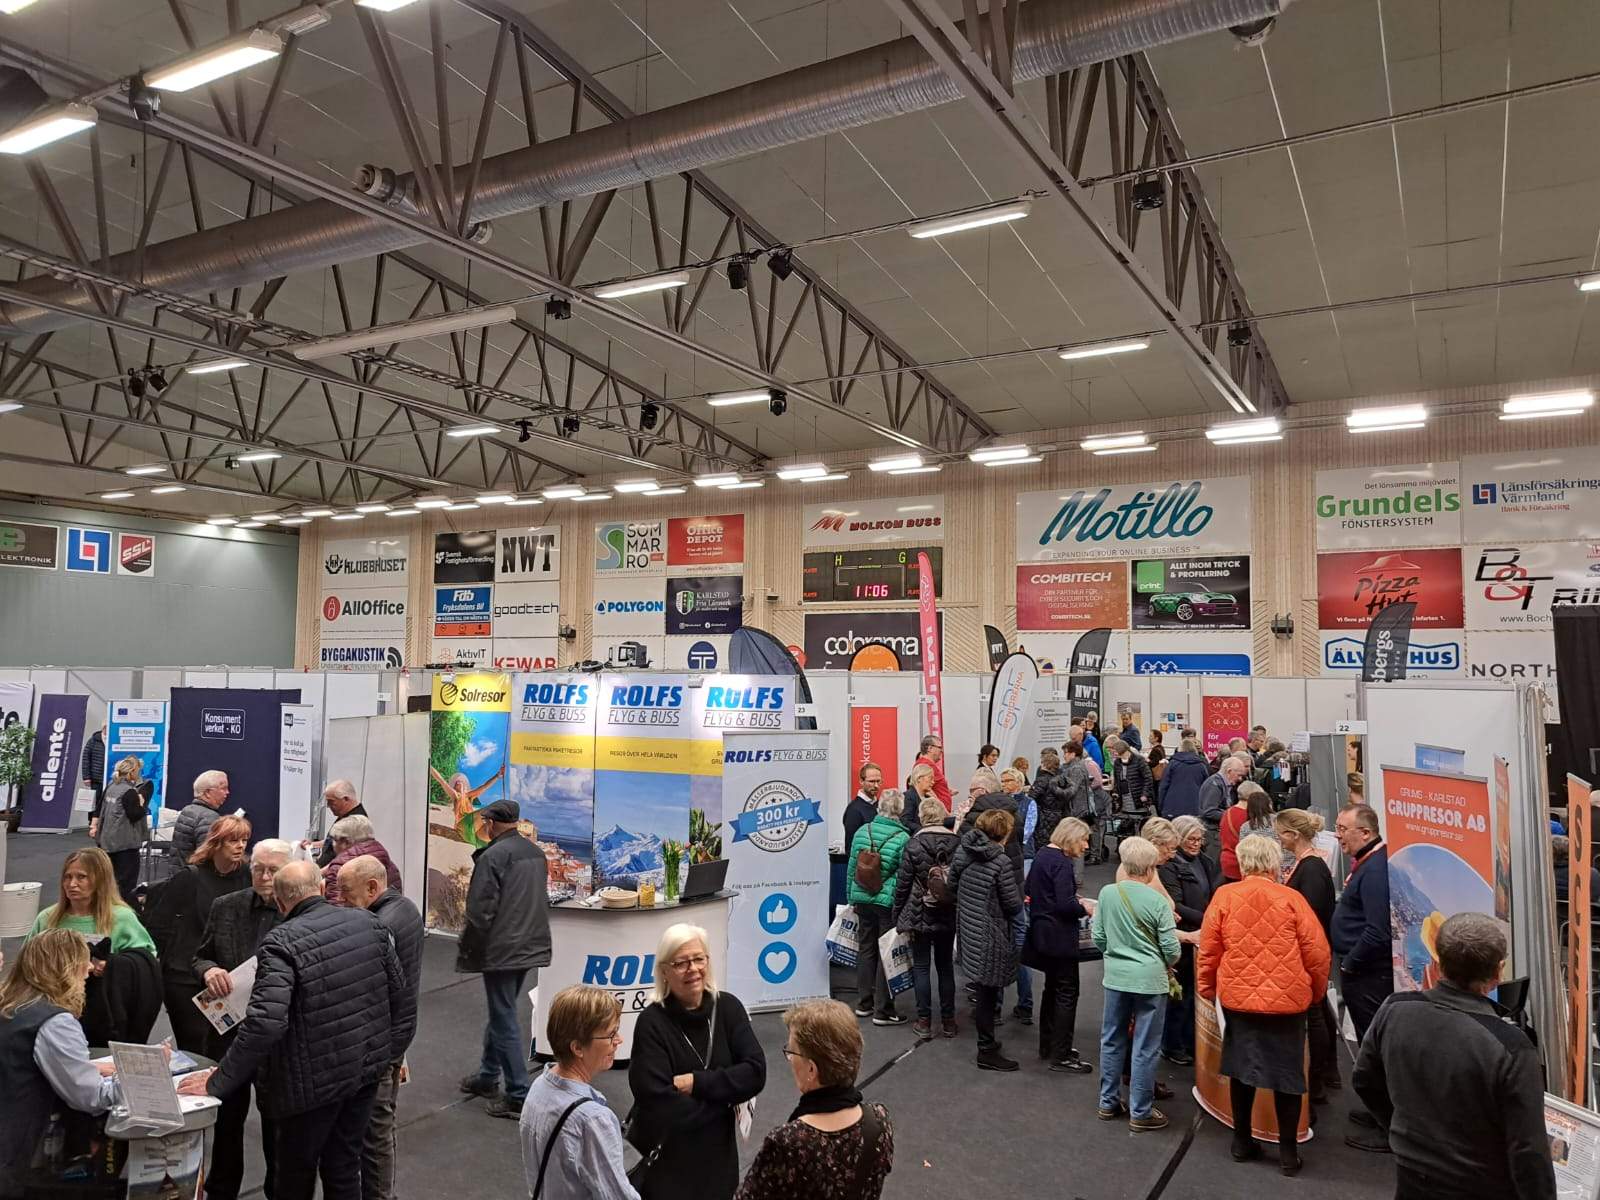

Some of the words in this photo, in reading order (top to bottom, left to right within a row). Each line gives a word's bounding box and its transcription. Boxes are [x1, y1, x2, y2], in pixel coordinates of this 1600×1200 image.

[1317, 489, 1460, 518] Grundels
[1502, 491, 1564, 503] Värmland
[1039, 481, 1213, 545] Motillo
[627, 522, 662, 537] SOM
[849, 520, 903, 531] MOLKOM
[906, 517, 942, 527] BUSS
[1342, 517, 1434, 528] FÖNSTERSYSTEM
[627, 538, 660, 553] MAR
[687, 535, 723, 544] DEPOT
[122, 540, 152, 562] SSL
[502, 534, 555, 573] NWT
[898, 552, 906, 563] G
[1052, 550, 1094, 558] EXPANDING
[1097, 549, 1117, 557] YOUR
[1119, 548, 1148, 556] ONLINE
[344, 558, 407, 574] KLUBBHUSET
[627, 554, 649, 568] RO
[834, 555, 842, 566] H
[1030, 572, 1112, 584] COMBITECH
[1178, 570, 1230, 578] PROFILERING
[855, 584, 889, 598] 11:06
[1354, 574, 1421, 601] Pizza
[342, 600, 405, 616] AllOffice
[494, 603, 558, 617] goodtech
[607, 601, 664, 613] POLYGON
[321, 647, 386, 662] BYGGAKUSTIK
[1077, 653, 1101, 667] NWT
[459, 688, 506, 703] Solresor
[524, 684, 588, 705] ROLFS
[611, 685, 683, 707] ROLFS
[706, 687, 784, 709] ROLFS
[1074, 685, 1098, 699] NWT
[1074, 700, 1097, 709] media
[205, 713, 241, 724] Konsument
[521, 706, 546, 719] FLYG
[549, 707, 557, 719] &
[559, 708, 586, 720] BUSS
[608, 709, 635, 723] FLYG
[638, 710, 647, 723] &
[651, 710, 680, 724] BUSS
[704, 711, 733, 726] FLYG
[735, 712, 745, 726] &
[750, 713, 781, 727] BUSS
[204, 724, 224, 733] verket
[230, 724, 241, 734] KO
[860, 714, 871, 765] kraterna
[39, 718, 67, 801] allente
[725, 750, 772, 763] ROLFS
[773, 750, 794, 760] FLYG
[796, 750, 804, 760] &
[806, 750, 828, 760] BUSS
[756, 808, 782, 825] 300
[785, 805, 800, 818] kr
[1387, 799, 1463, 828] GRUPPRESOR
[1467, 814, 1486, 832] AB
